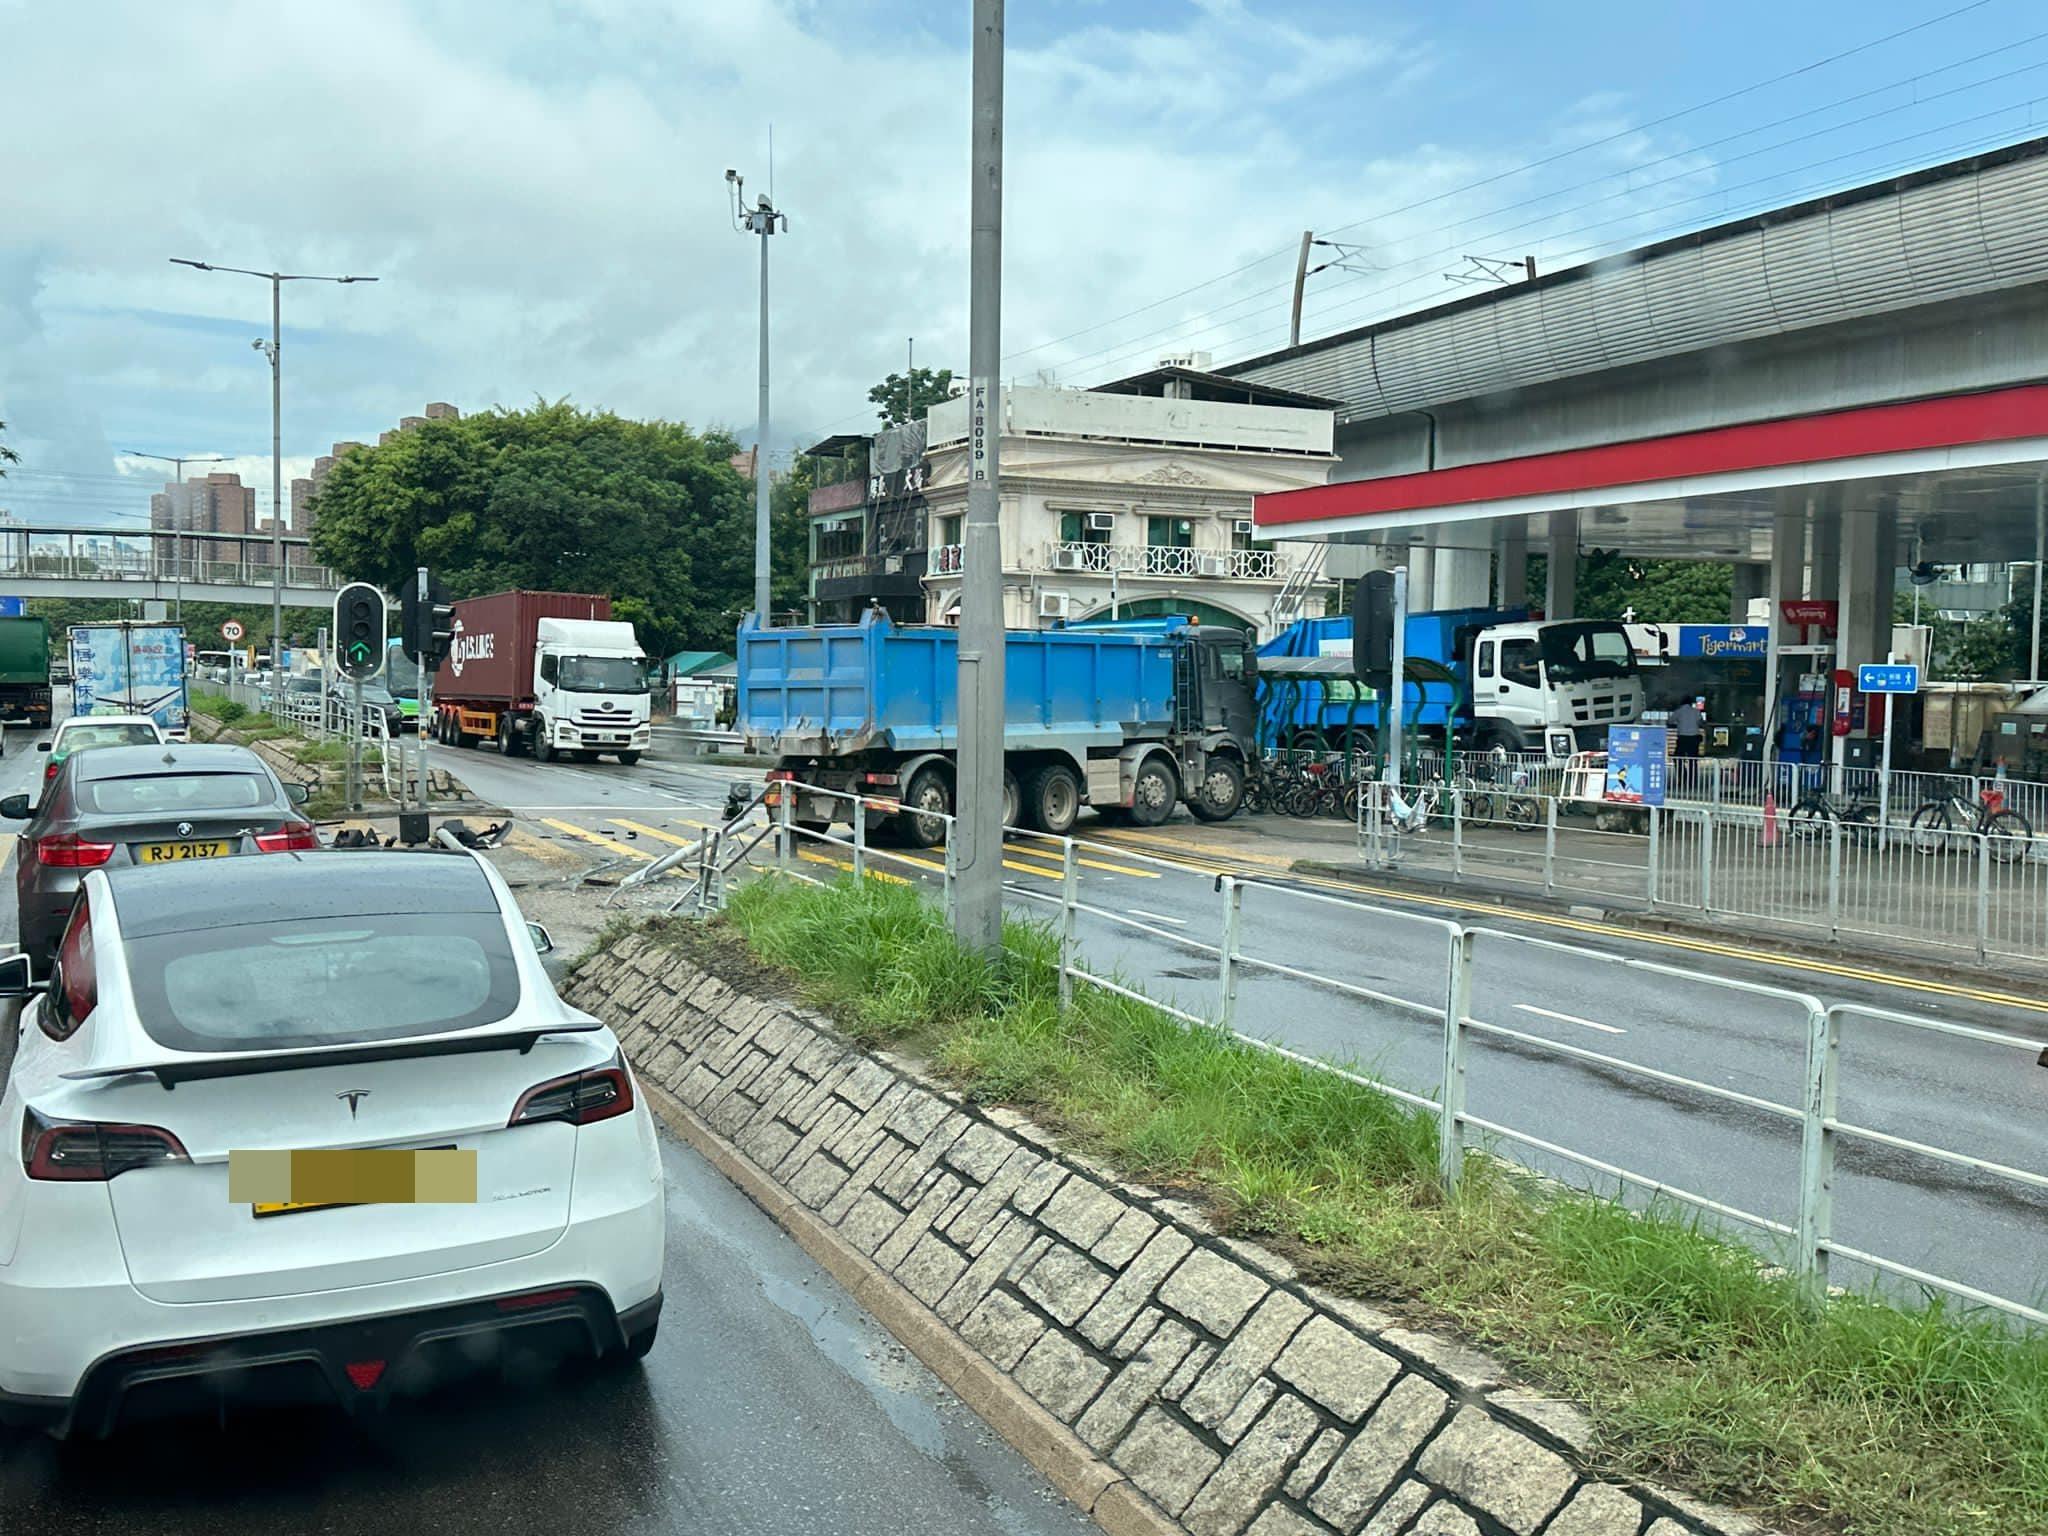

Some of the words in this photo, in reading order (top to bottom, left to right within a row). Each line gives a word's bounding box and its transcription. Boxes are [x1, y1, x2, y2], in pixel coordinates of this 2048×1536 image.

[225, 626, 240, 636] 70
[1698, 634, 1768, 656] Tigermart
[151, 845, 174, 861] RJ
[180, 843, 219, 859] 2137
